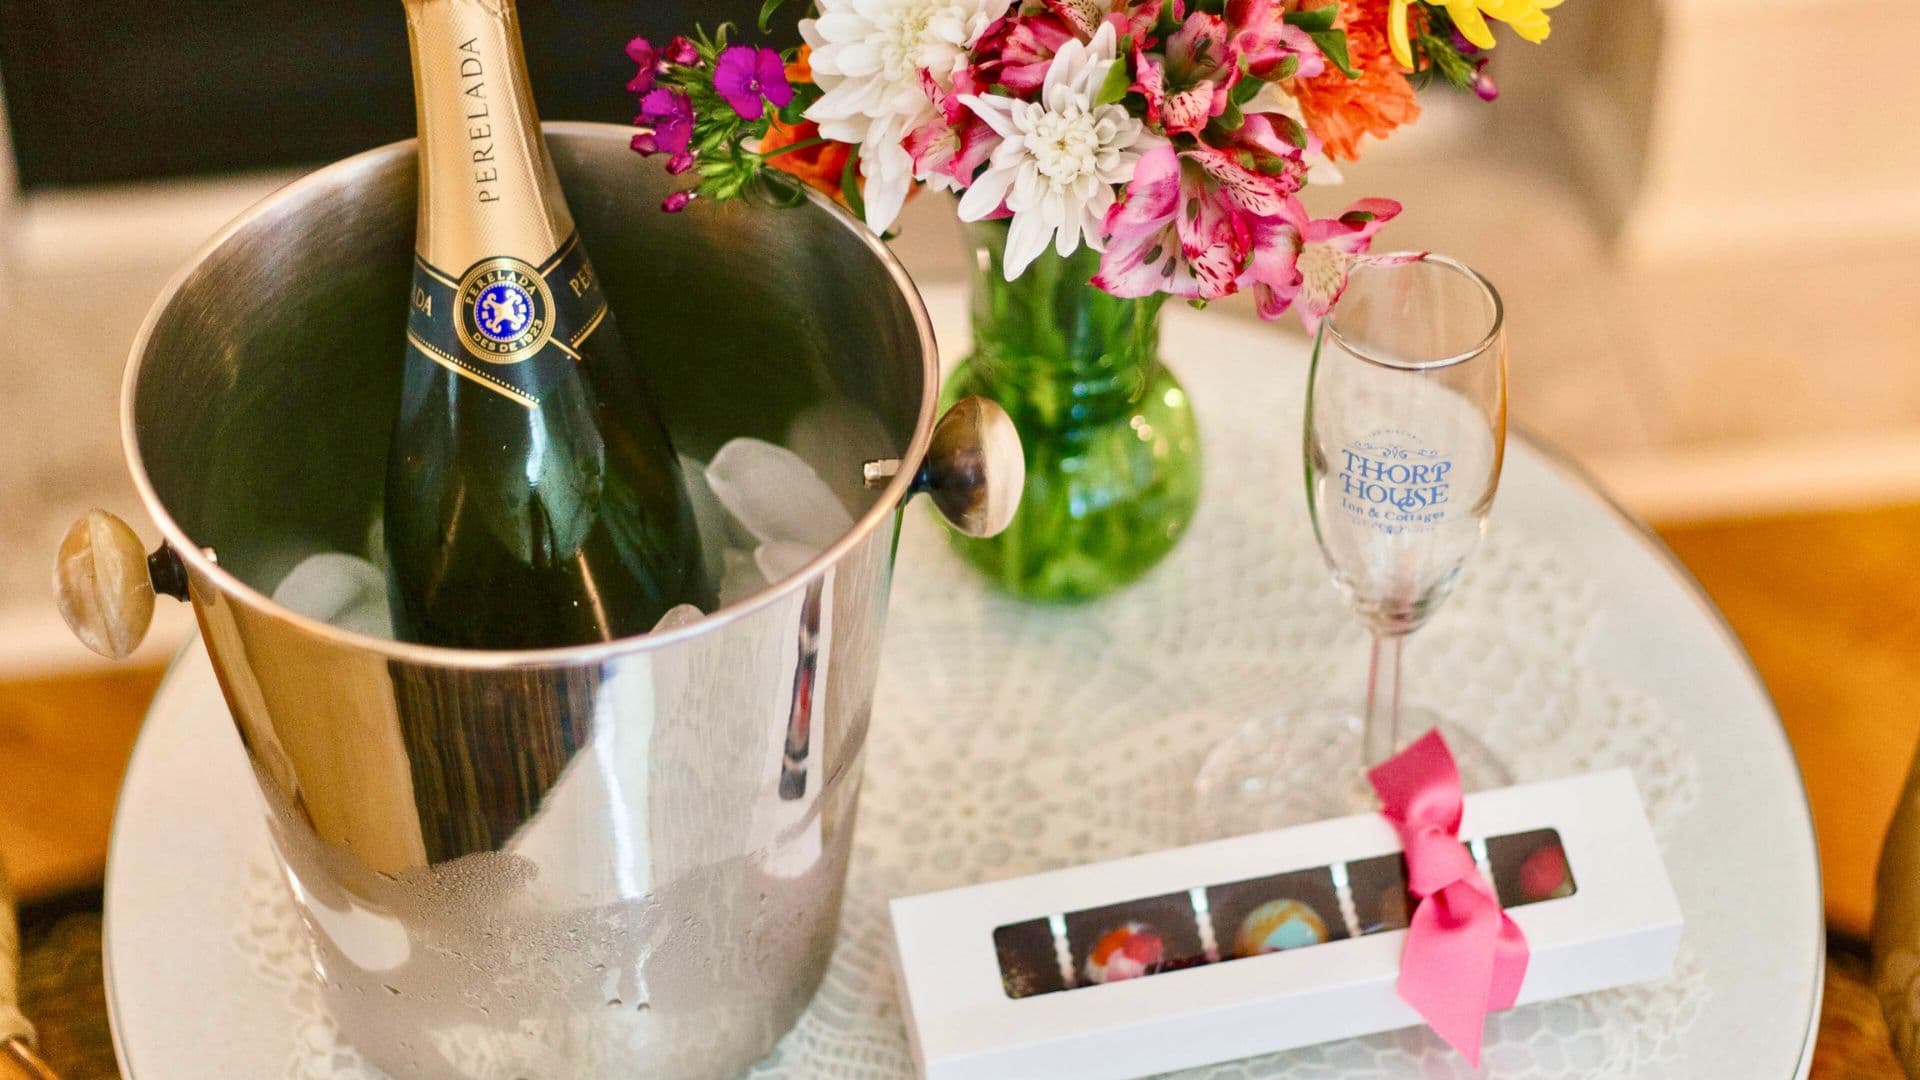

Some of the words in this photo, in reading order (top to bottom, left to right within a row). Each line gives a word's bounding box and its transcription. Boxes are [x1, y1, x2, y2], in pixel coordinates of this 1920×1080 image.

[459, 37, 500, 203] PERELADA
[466, 270, 537, 305] PERELADA
[519, 319, 543, 346] 1923
[1341, 448, 1451, 485] THORP
[1339, 472, 1449, 513] HOUSE
[1342, 497, 1364, 515] Inn
[1368, 507, 1380, 519] &
[1384, 510, 1445, 524] Cottages
